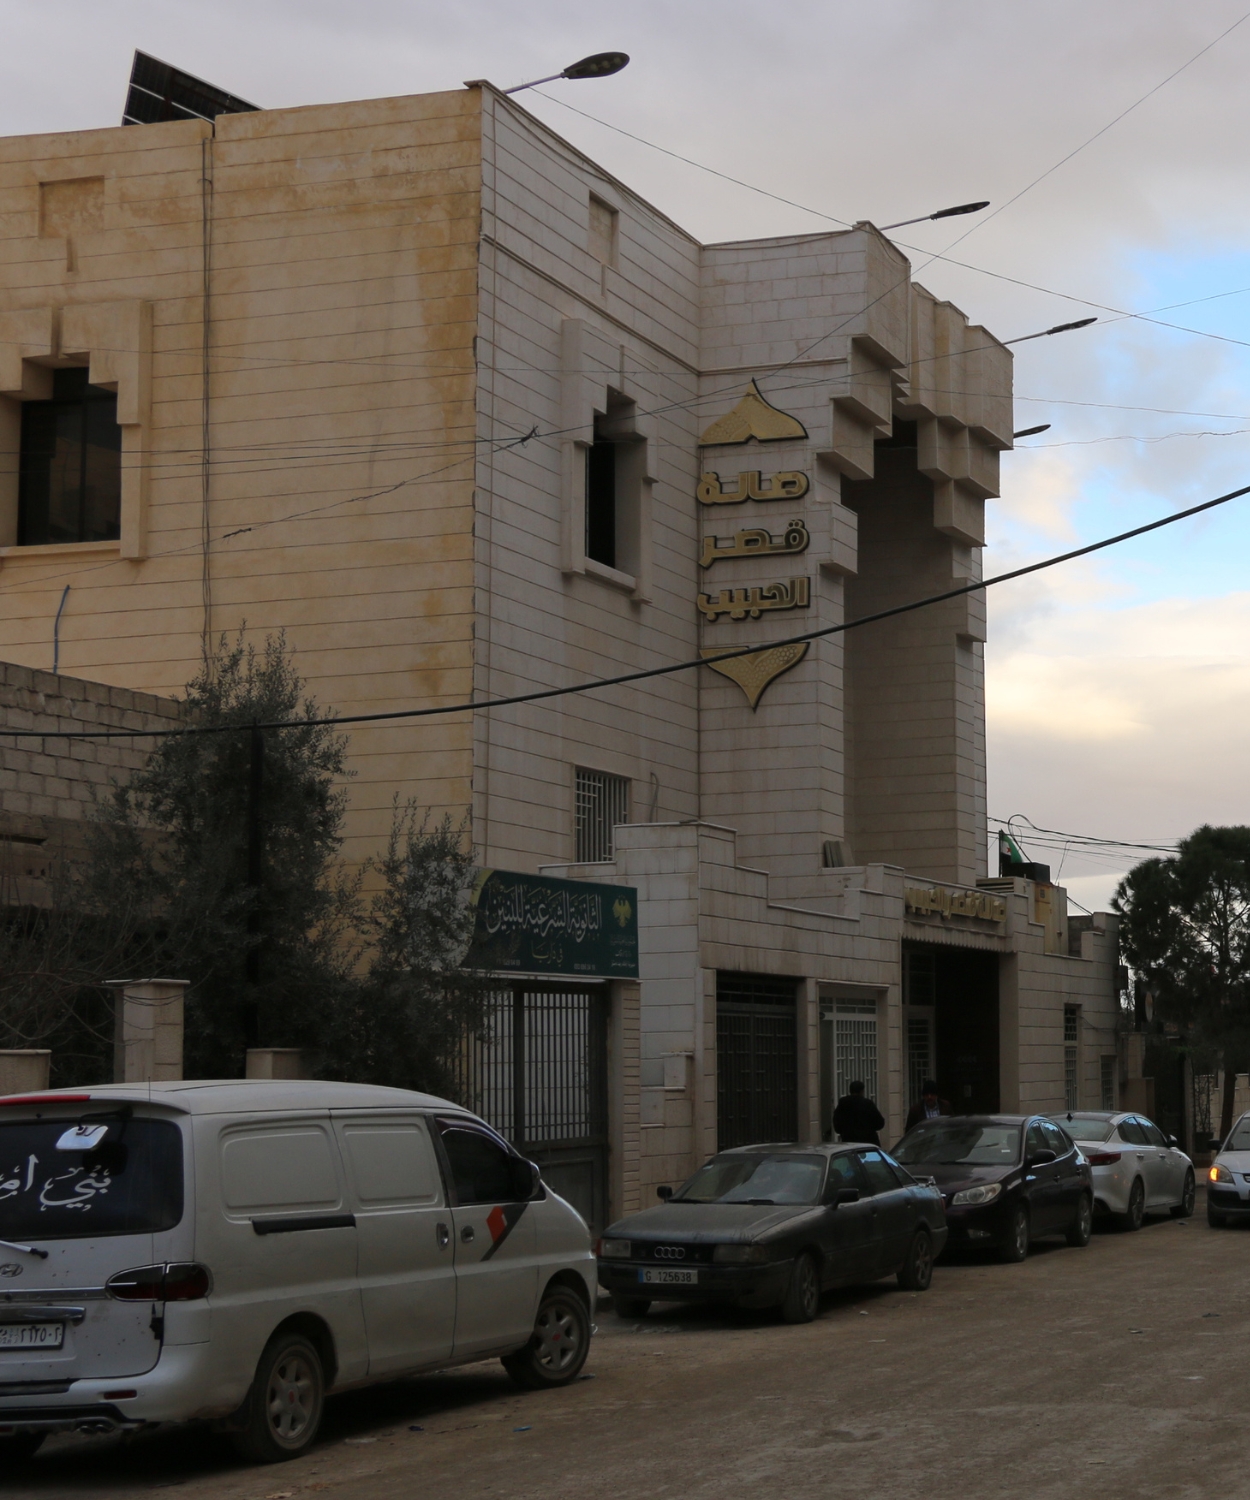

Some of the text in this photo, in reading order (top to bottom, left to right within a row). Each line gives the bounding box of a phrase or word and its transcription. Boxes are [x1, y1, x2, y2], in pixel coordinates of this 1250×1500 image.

[697, 471, 810, 506] صالة
[699, 519, 811, 570] قصر
[697, 576, 812, 622] الحبيب
[658, 1271, 692, 1283] 125638
